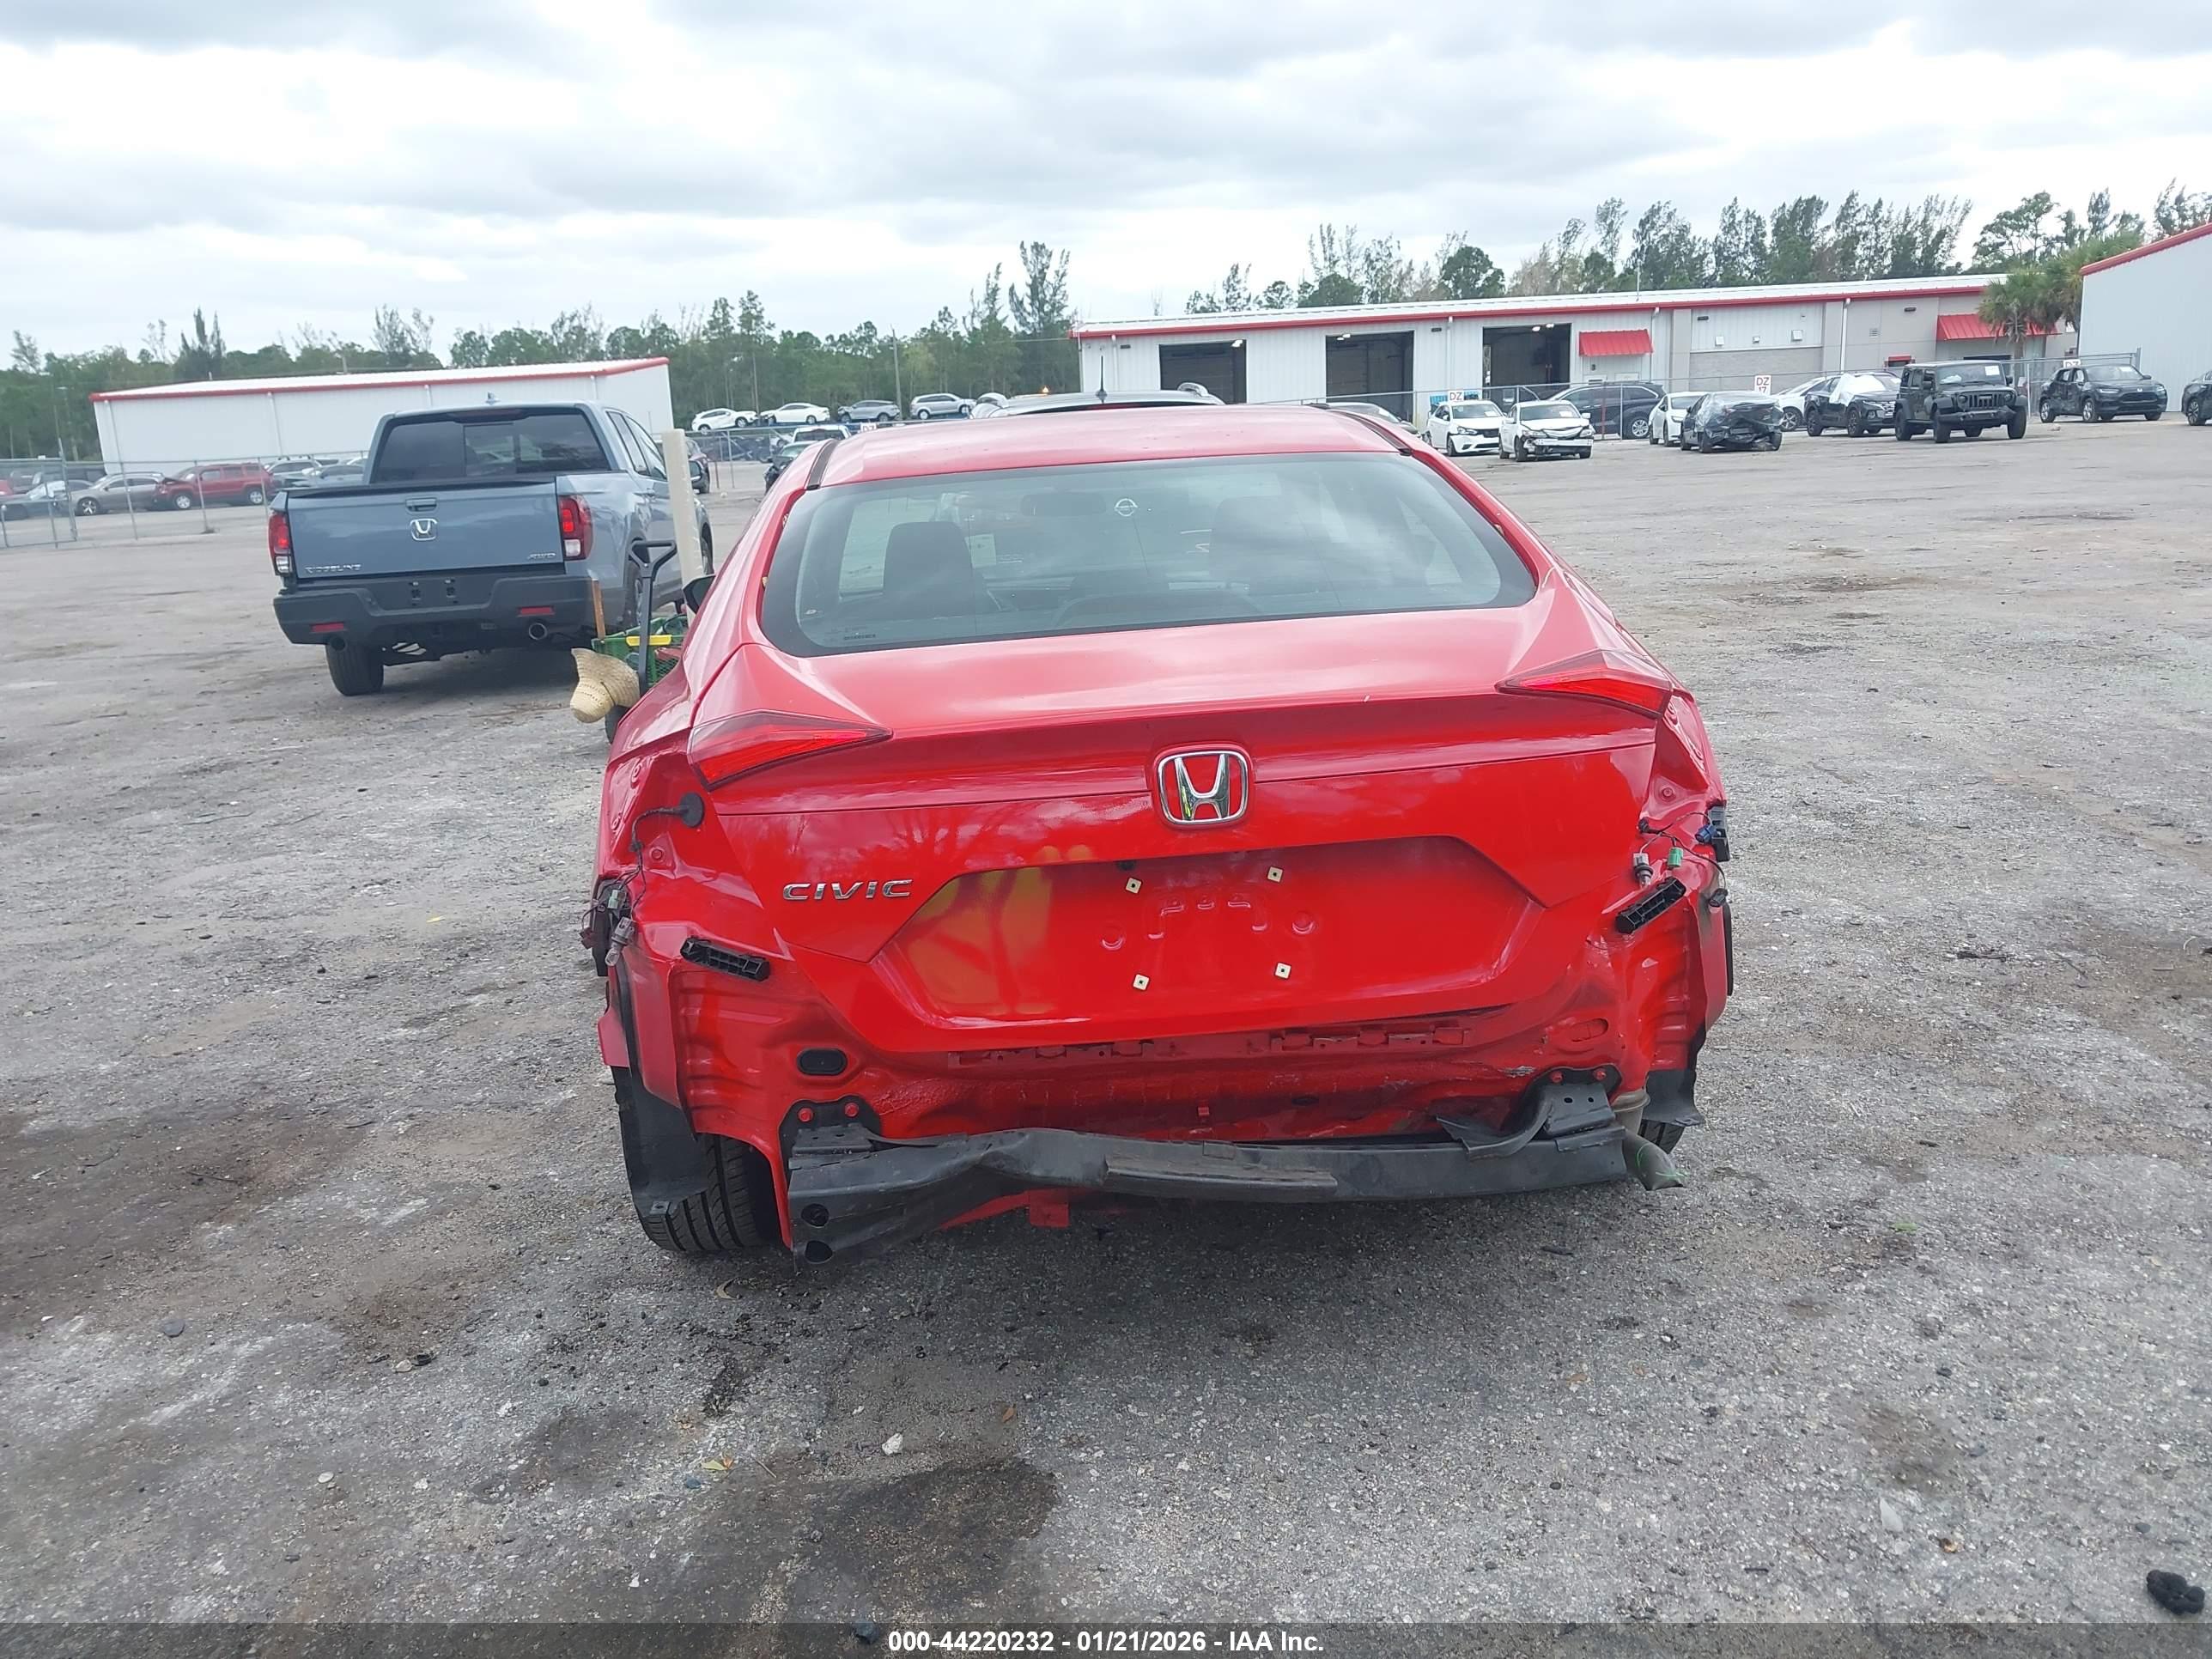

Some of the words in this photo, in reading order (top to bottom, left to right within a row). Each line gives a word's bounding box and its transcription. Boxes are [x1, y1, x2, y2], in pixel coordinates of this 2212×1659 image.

[1757, 377, 1769, 386] DZ
[1449, 392, 1462, 400] DZ
[783, 879, 912, 901] CIVIC
